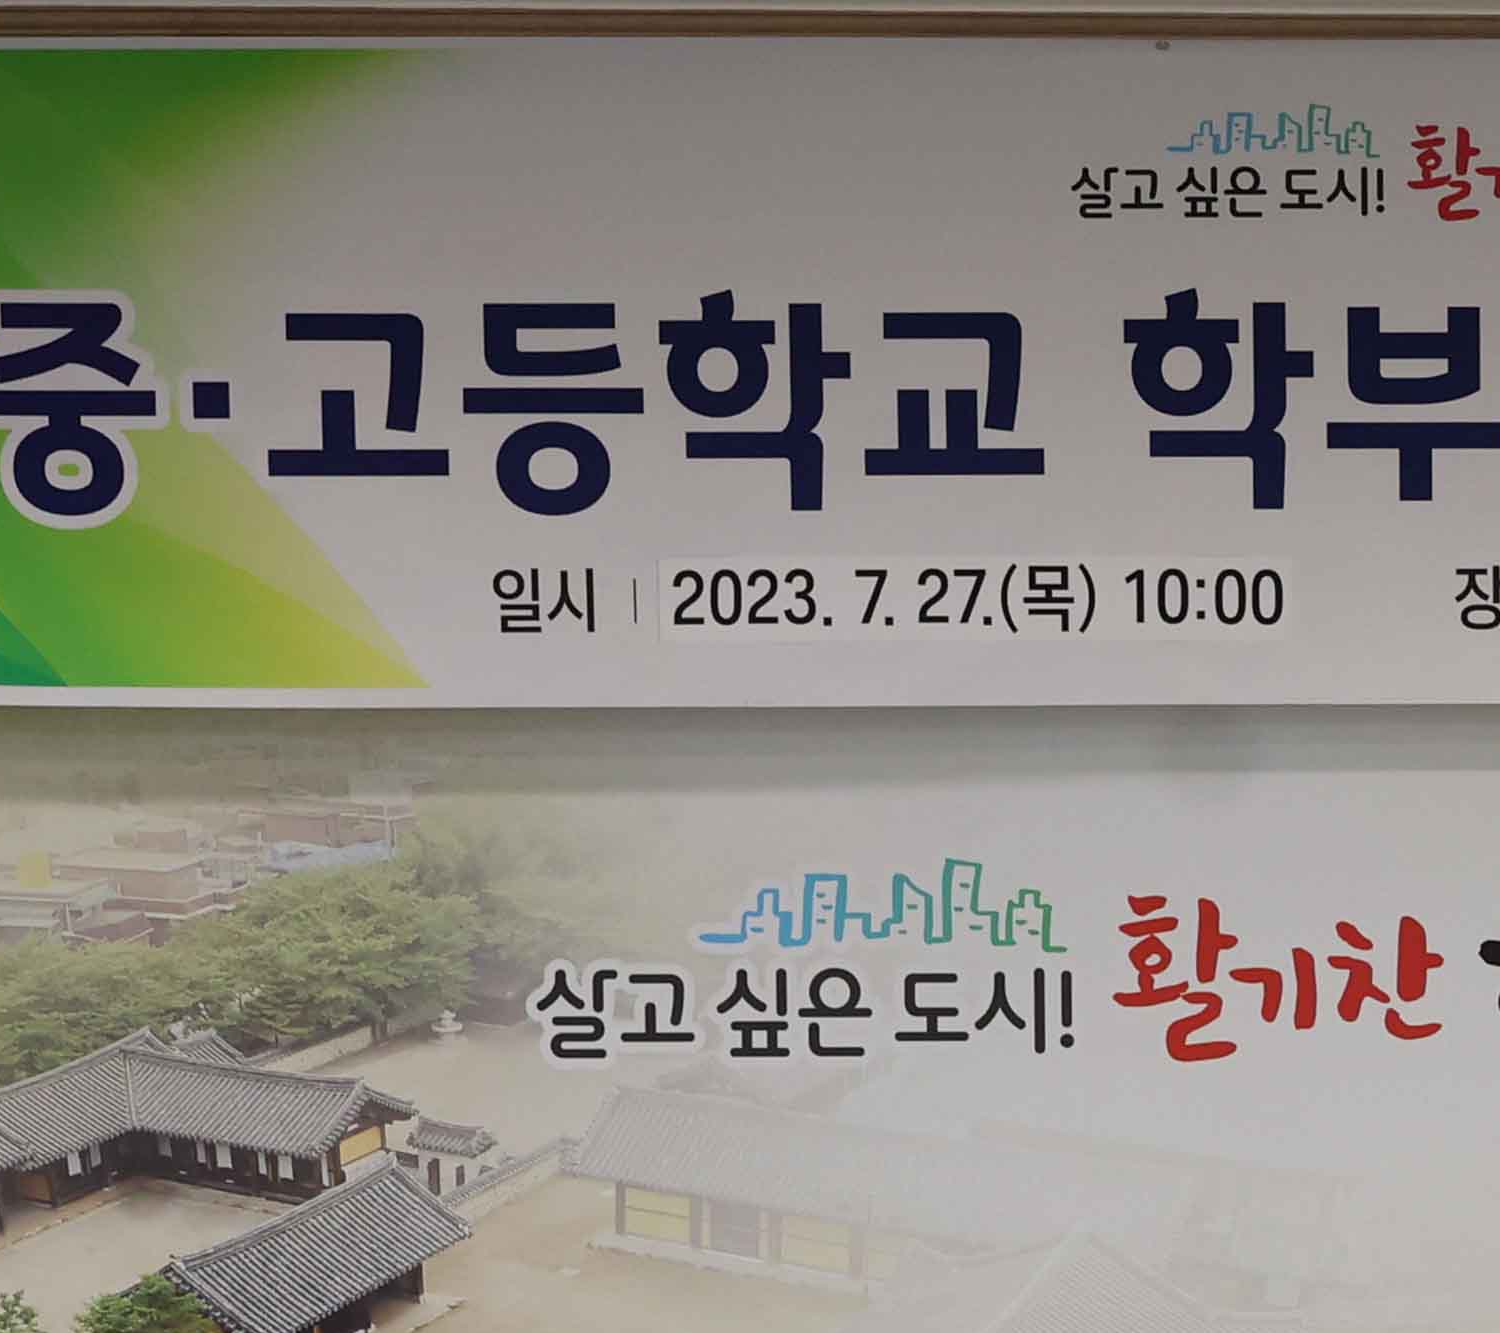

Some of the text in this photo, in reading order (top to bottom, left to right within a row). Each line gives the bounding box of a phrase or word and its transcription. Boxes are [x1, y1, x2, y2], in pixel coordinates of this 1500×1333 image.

[1070, 165, 1164, 219] 살고
[1175, 165, 1268, 219] 싶은
[1279, 165, 1385, 219] 도시!
[492, 563, 1285, 634] 일시 2023. 7. 27.(목) 10:00
[535, 967, 697, 1060] 살고
[716, 966, 870, 1060] 싶은
[899, 966, 1076, 1057] 도시!
[1111, 894, 1445, 1064] 활기찬
